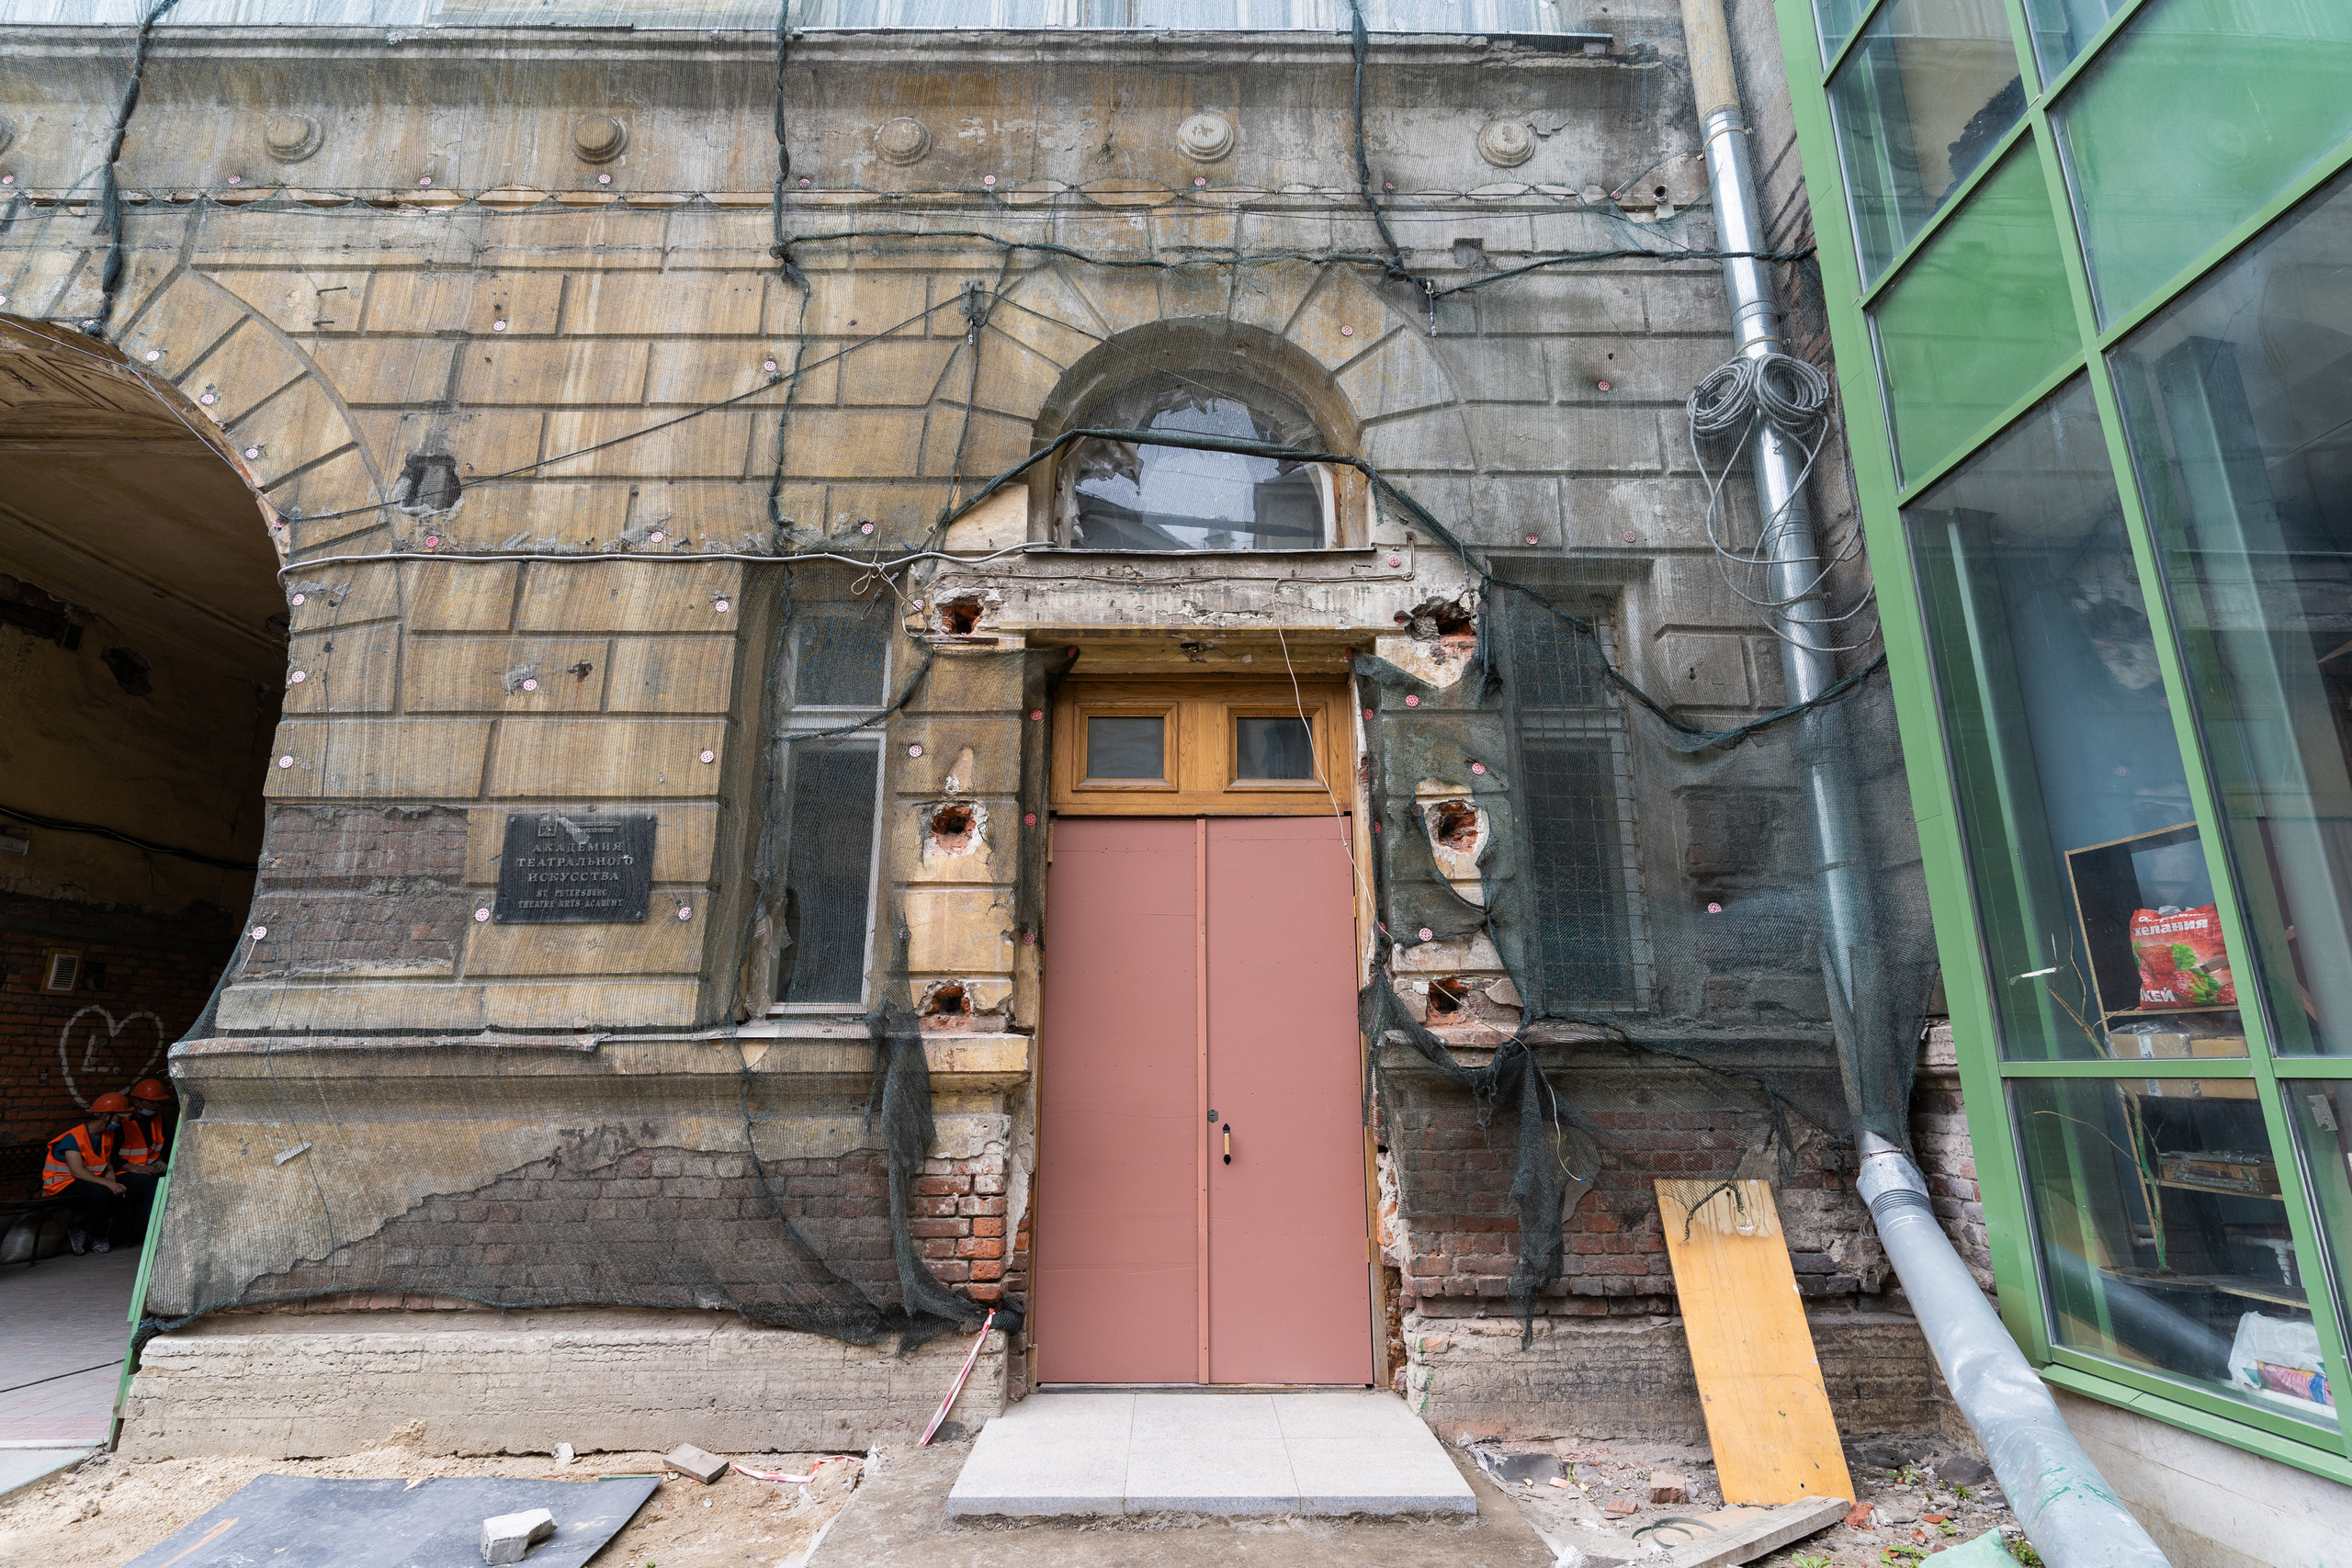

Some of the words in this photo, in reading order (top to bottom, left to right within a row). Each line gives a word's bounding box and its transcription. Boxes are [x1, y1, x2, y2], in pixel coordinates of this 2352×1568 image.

[533, 842, 624, 852] АКАДЕМИЯ
[517, 856, 633, 866] ТЕАТРАЛЬНОГО
[528, 873, 619, 882] ИСКУССТВА
[537, 889, 548, 897] ST
[555, 889, 607, 897] PETERSBURG
[518, 900, 554, 908] THEATRE
[559, 899, 581, 908] ARTS
